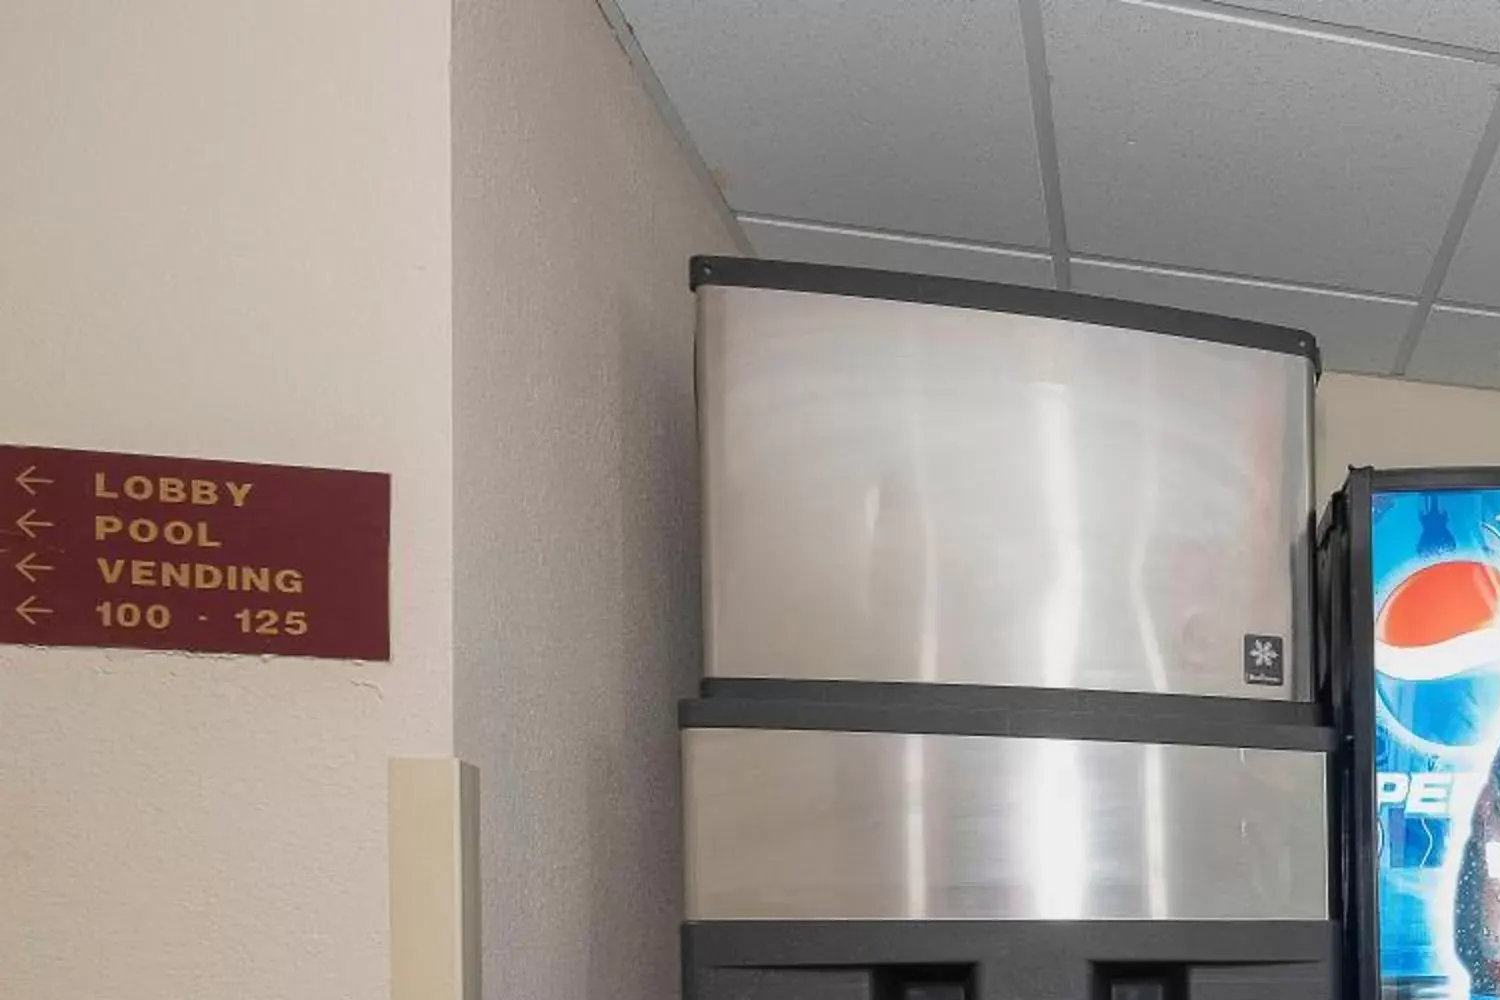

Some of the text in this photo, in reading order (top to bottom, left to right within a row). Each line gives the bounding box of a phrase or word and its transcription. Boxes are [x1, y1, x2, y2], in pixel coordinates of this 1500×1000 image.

[95, 472, 254, 507] LOBBY
[95, 515, 222, 547] POOL
[97, 558, 303, 593] VENDING
[96, 601, 172, 629] 100
[235, 608, 308, 636] 125
